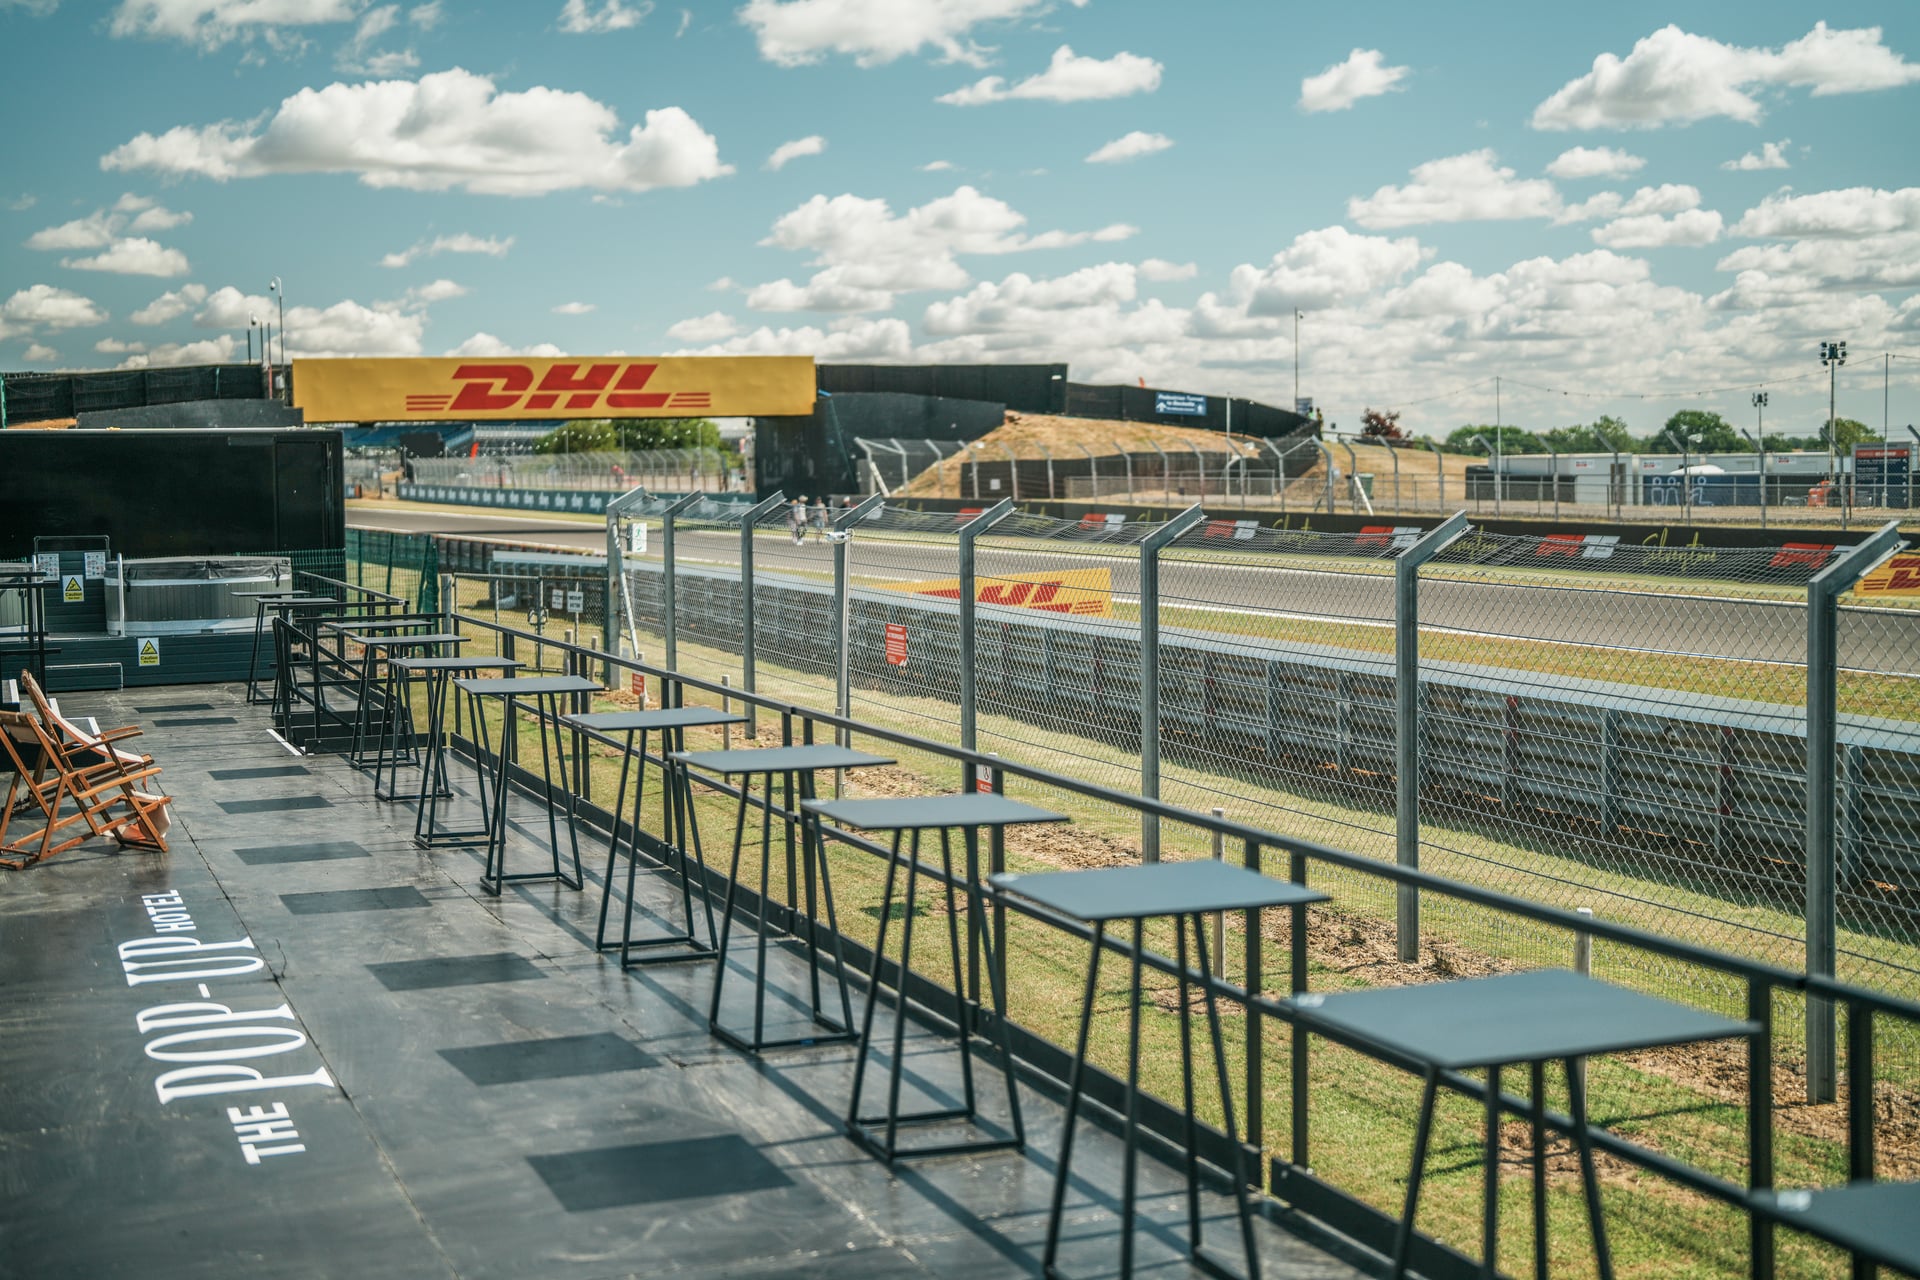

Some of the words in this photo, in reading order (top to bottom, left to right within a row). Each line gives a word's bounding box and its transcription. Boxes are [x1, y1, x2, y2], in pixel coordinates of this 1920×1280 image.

[448, 363, 671, 411] DHL
[141, 889, 197, 933] HOTEL
[118, 936, 335, 1105] POP-UP
[227, 1102, 306, 1165] THE
